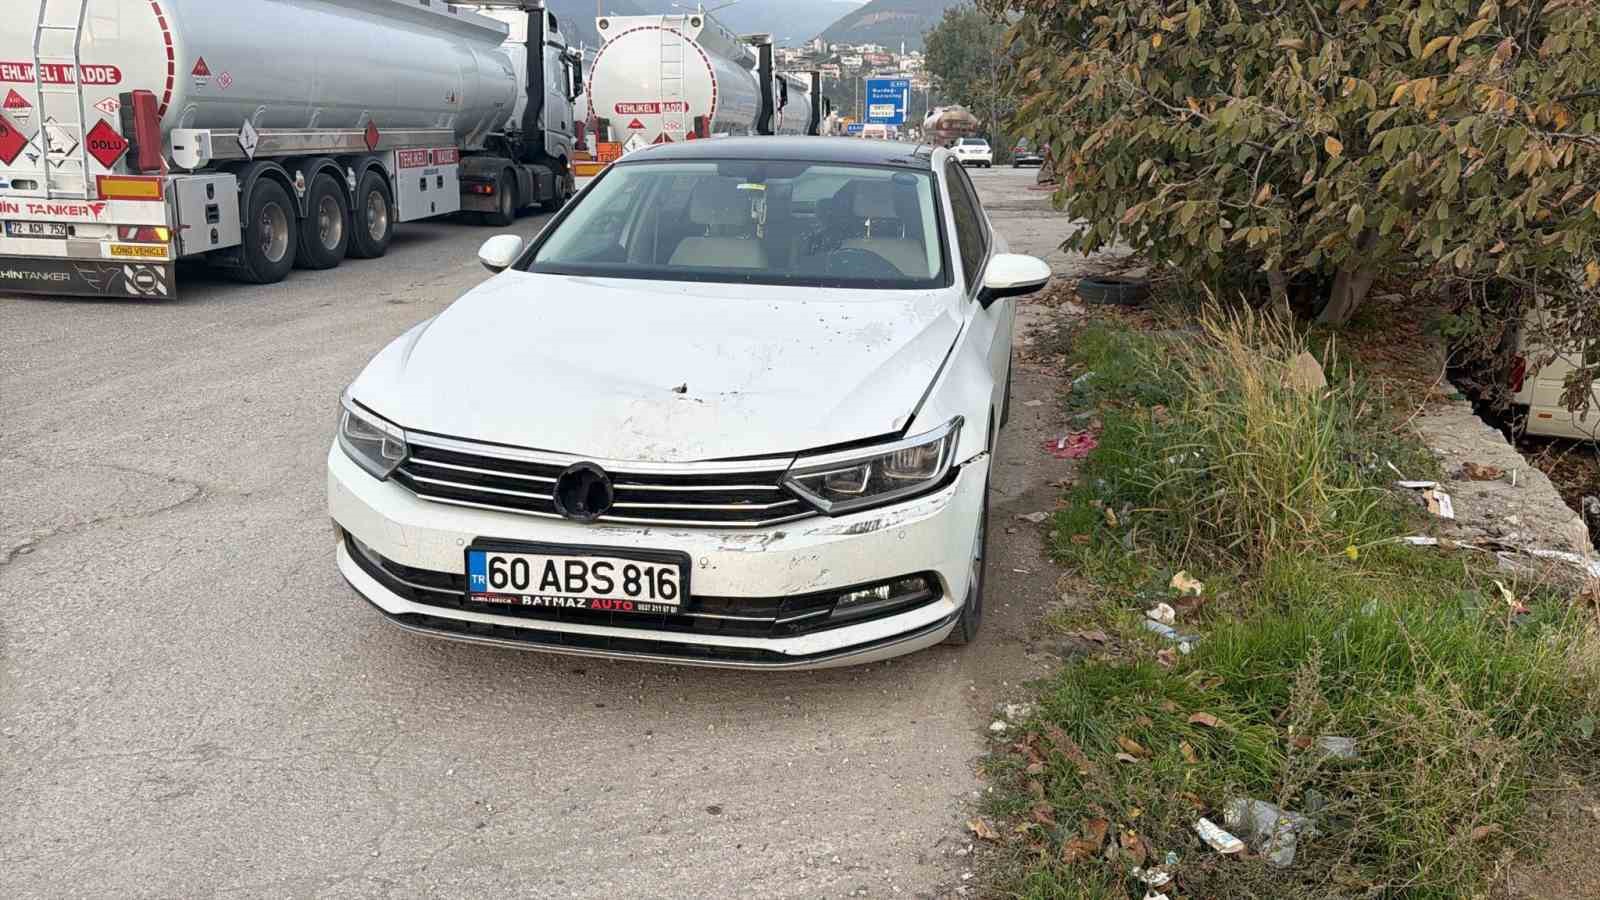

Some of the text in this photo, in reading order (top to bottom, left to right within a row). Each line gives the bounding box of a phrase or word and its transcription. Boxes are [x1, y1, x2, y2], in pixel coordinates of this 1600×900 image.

[0, 64, 58, 82] EHLİKELİ
[659, 103, 684, 113] MADD
[91, 140, 122, 150] DOLU
[0, 201, 89, 216] İN TANKER
[13, 222, 23, 233] 72
[49, 224, 65, 235] 752
[111, 245, 167, 257] LONG VEHICLE
[471, 574, 486, 585] TR
[488, 556, 677, 600] 60 ABS 816
[522, 595, 586, 608] BATMAZ
[591, 599, 633, 610] AUTO
